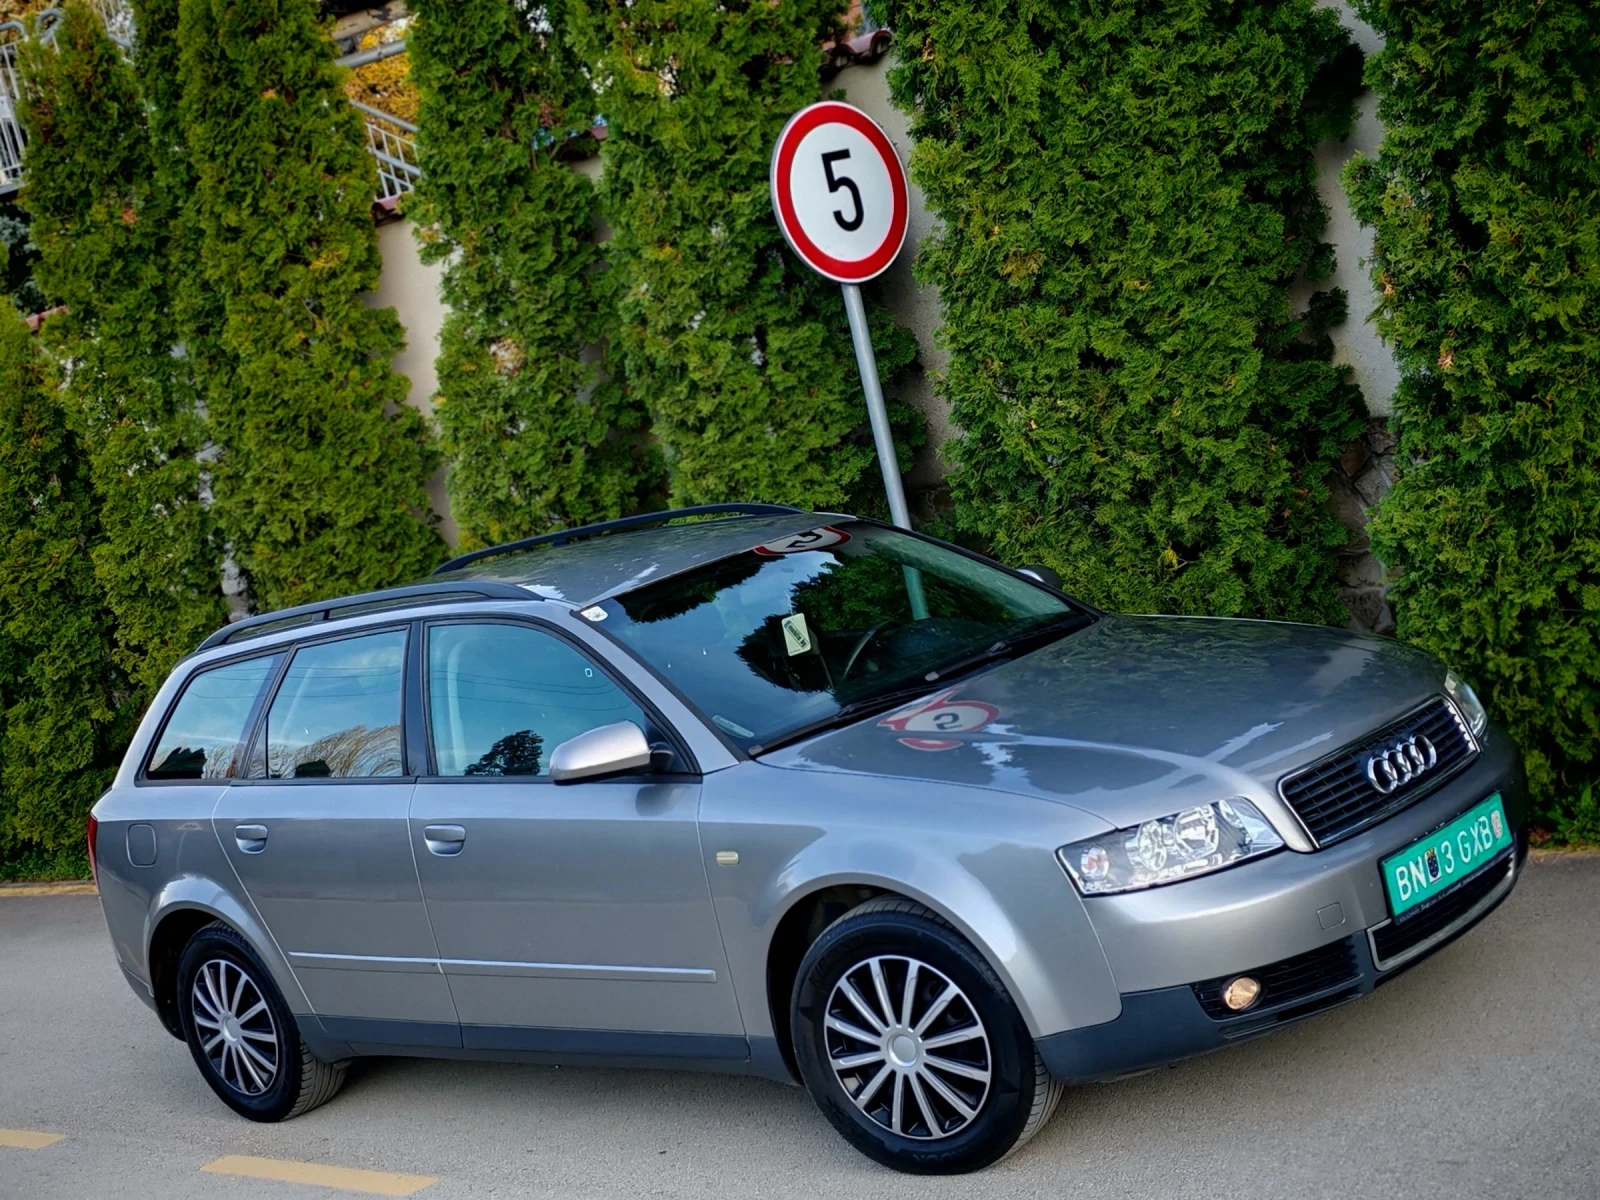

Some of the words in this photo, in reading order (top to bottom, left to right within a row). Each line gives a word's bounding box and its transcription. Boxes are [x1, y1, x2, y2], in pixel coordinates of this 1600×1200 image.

[821, 148, 864, 232] 5
[1395, 855, 1427, 901] BN
[1440, 840, 1455, 874] 3
[1456, 815, 1492, 863] GXB
